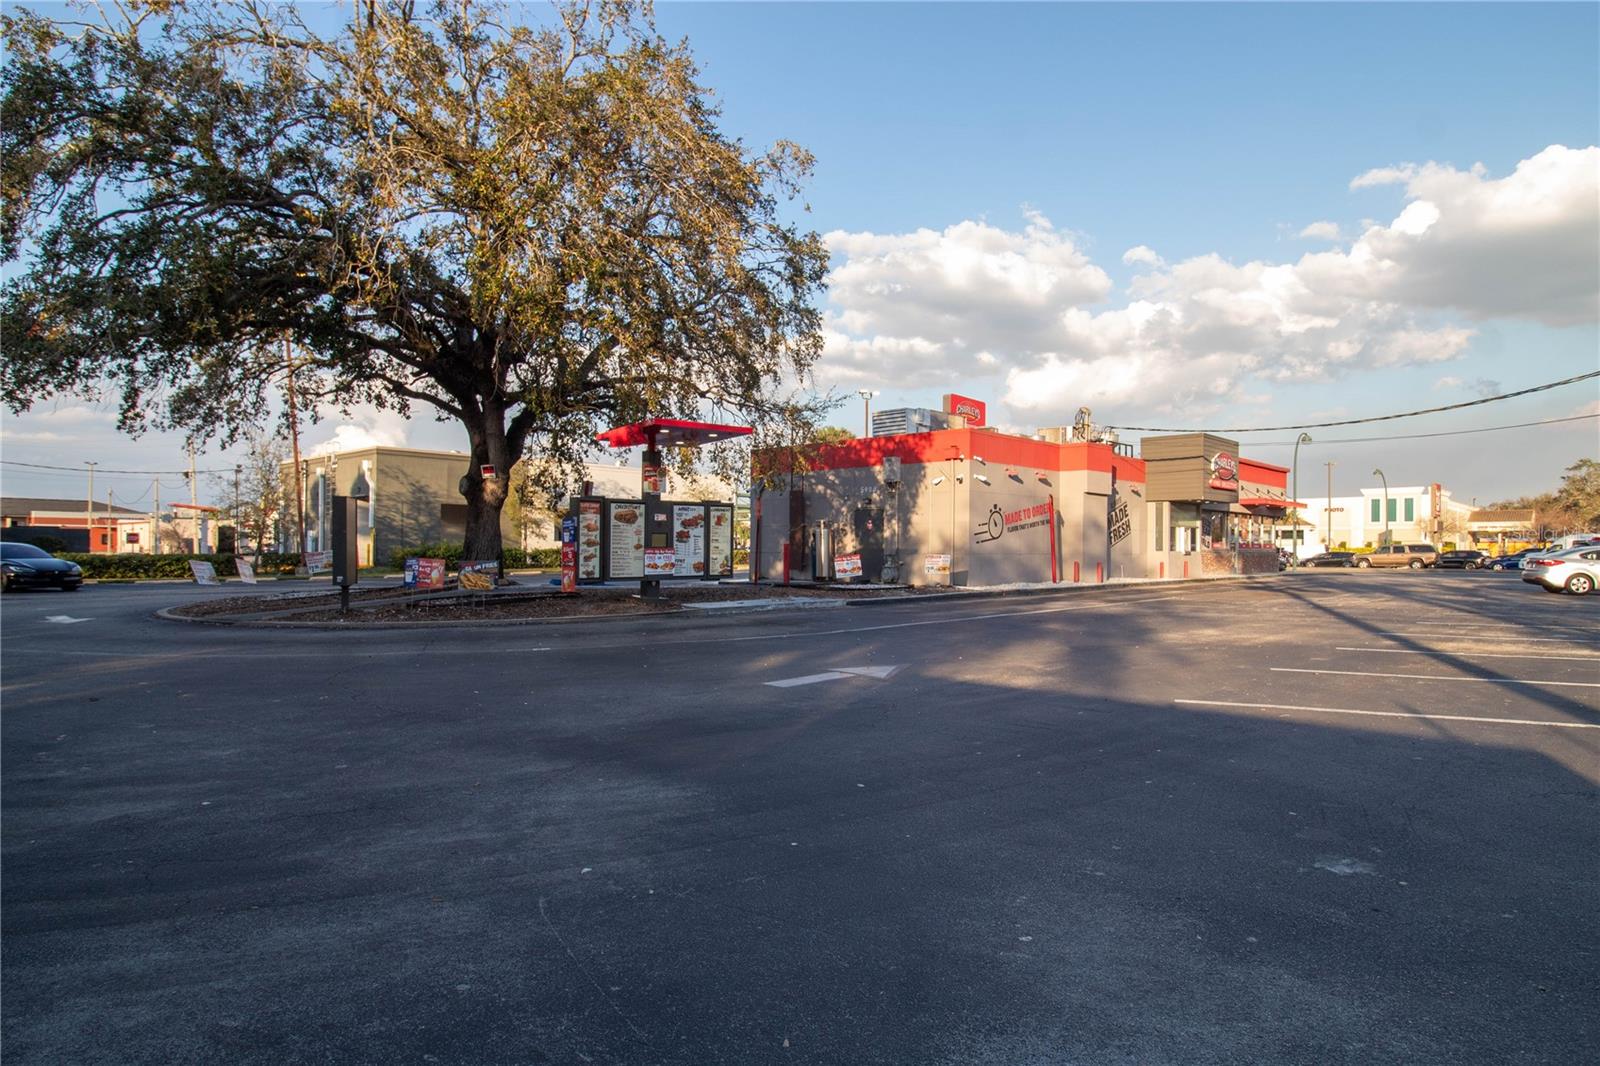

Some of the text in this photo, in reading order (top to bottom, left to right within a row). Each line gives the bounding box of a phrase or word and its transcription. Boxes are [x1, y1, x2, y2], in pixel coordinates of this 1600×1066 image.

[1004, 509, 1023, 526] MADE
[1023, 506, 1031, 519] TO
[1107, 503, 1129, 530] MADE
[1108, 518, 1132, 545] FRESH
